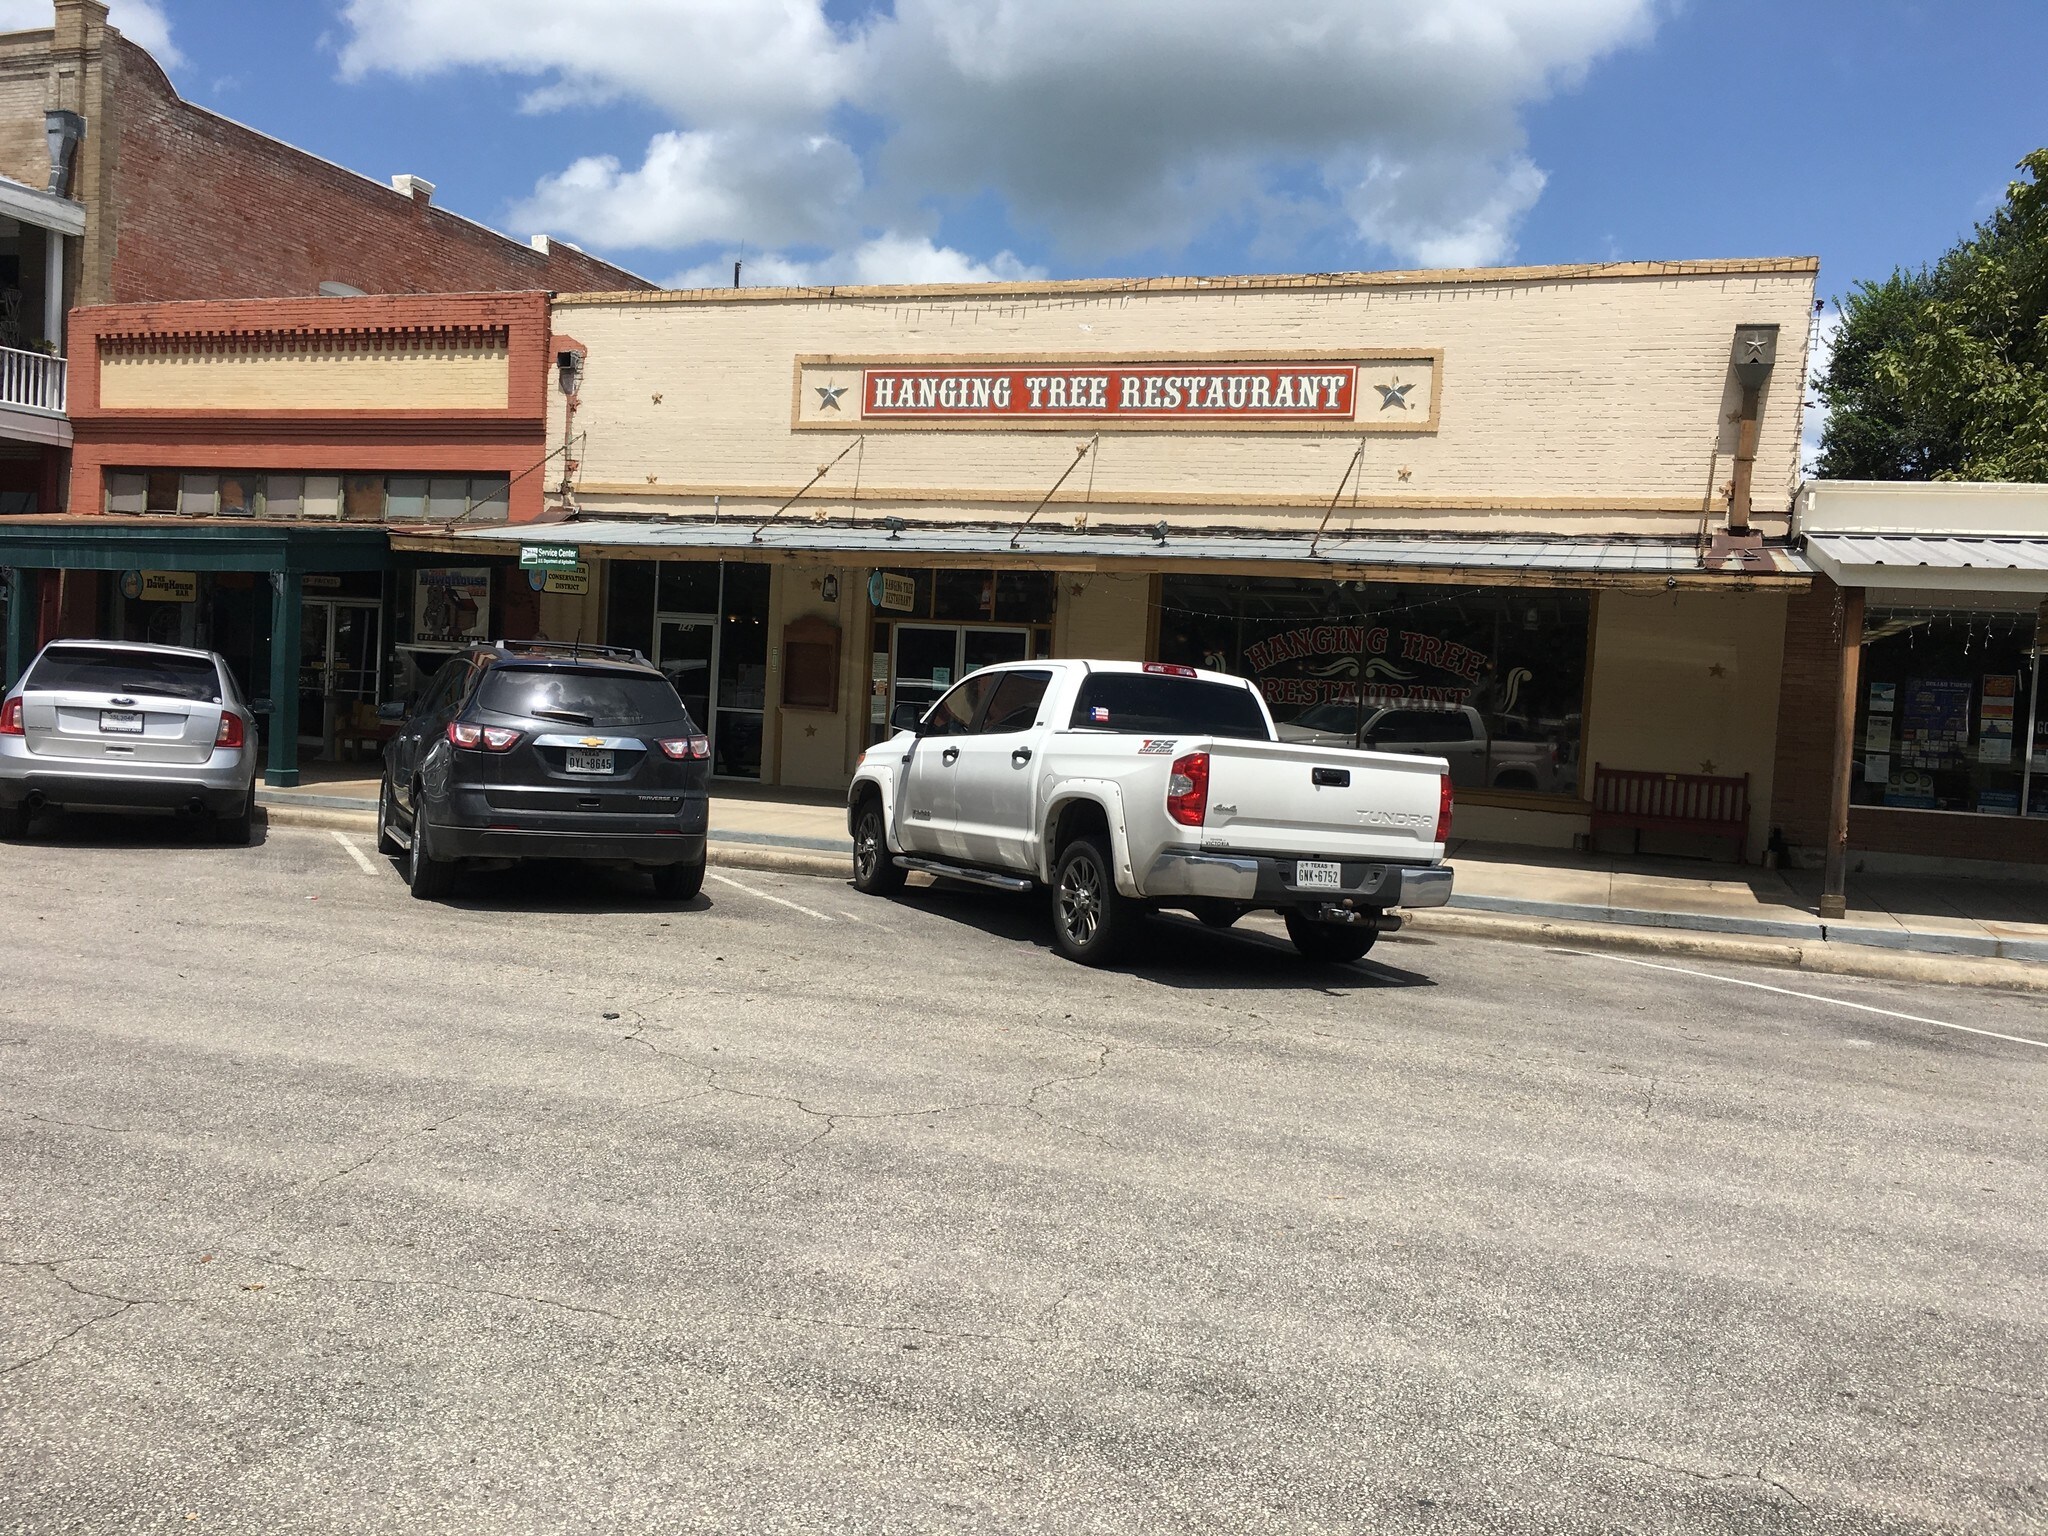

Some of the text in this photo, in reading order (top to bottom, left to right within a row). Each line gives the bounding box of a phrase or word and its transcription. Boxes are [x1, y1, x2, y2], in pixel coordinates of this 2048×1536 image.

[873, 375, 1346, 408] HANGING TREE RESTAURANT
[538, 548, 557, 557] Service
[558, 548, 576, 558] Center
[548, 573, 587, 582] CONSERVATION
[1243, 625, 1488, 686] HANGING TREE
[1260, 677, 1471, 713] RESTAURANT
[1143, 740, 1178, 749] TSS
[1356, 810, 1433, 828] TUNDRA
